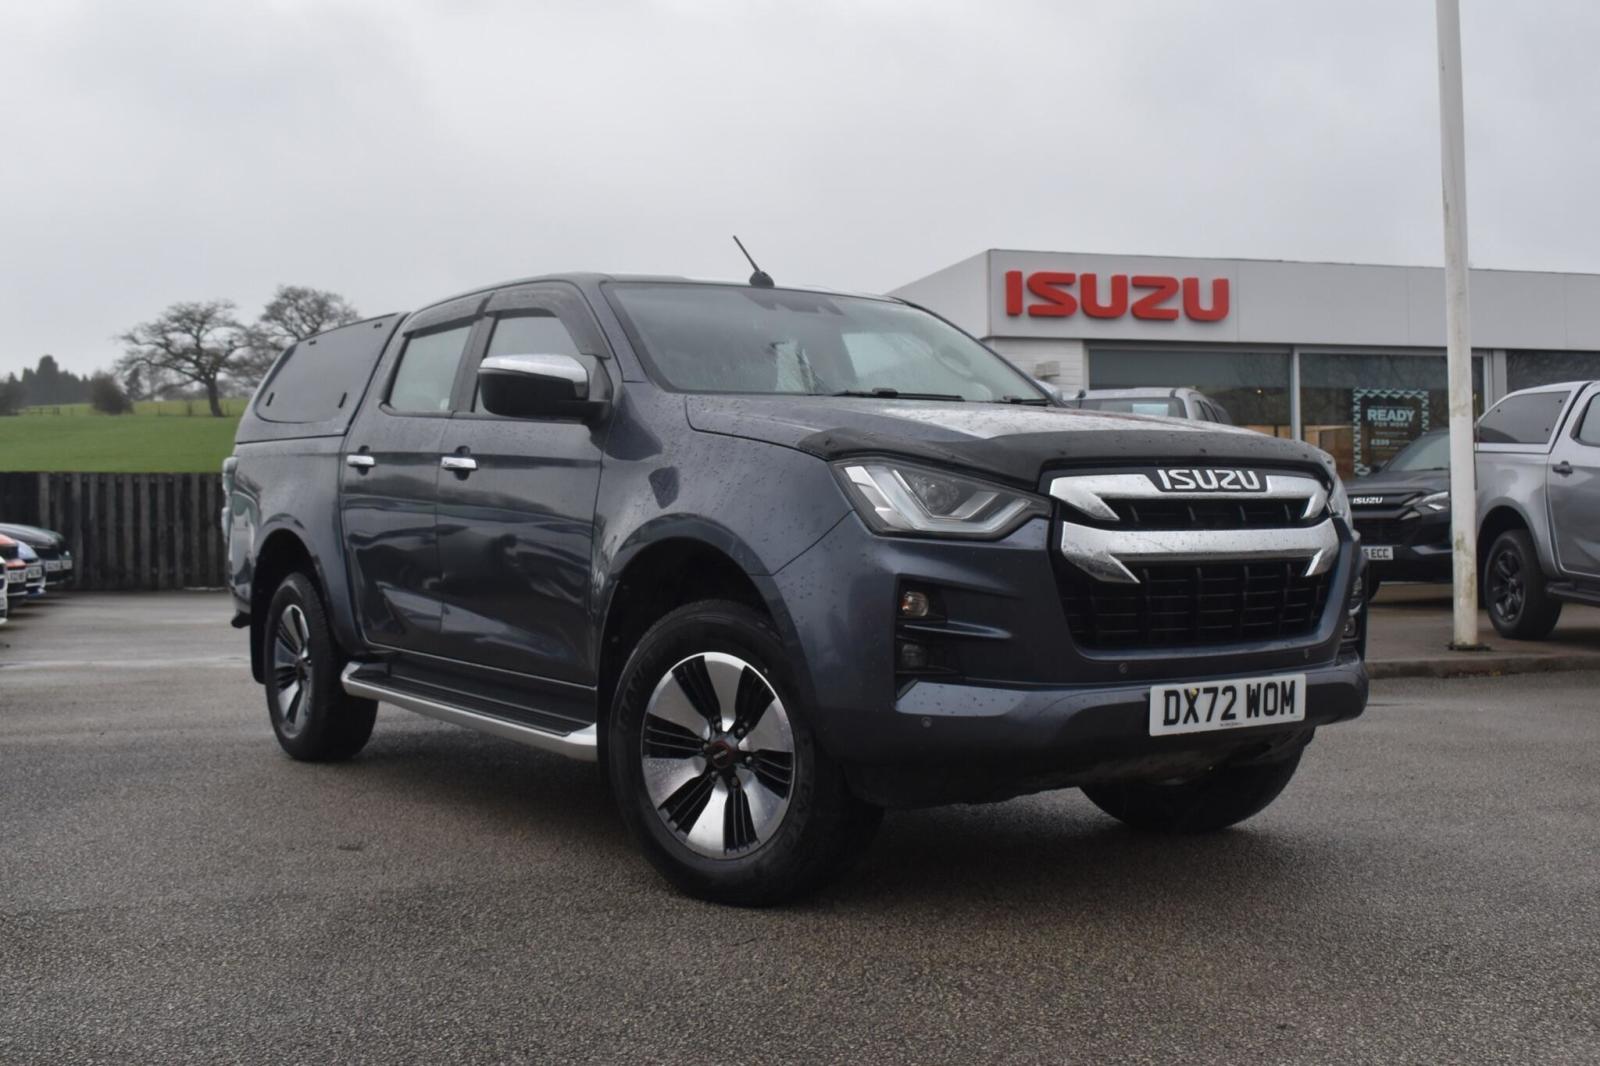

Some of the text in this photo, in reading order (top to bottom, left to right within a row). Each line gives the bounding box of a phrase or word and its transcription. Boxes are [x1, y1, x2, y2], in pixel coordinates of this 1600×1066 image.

[1005, 270, 1230, 322] ISUZU
[1367, 409, 1415, 422] READY
[1157, 469, 1260, 489] ISUZU
[1353, 496, 1383, 504] ISUZU
[1163, 680, 1296, 726] DX72 WOM
